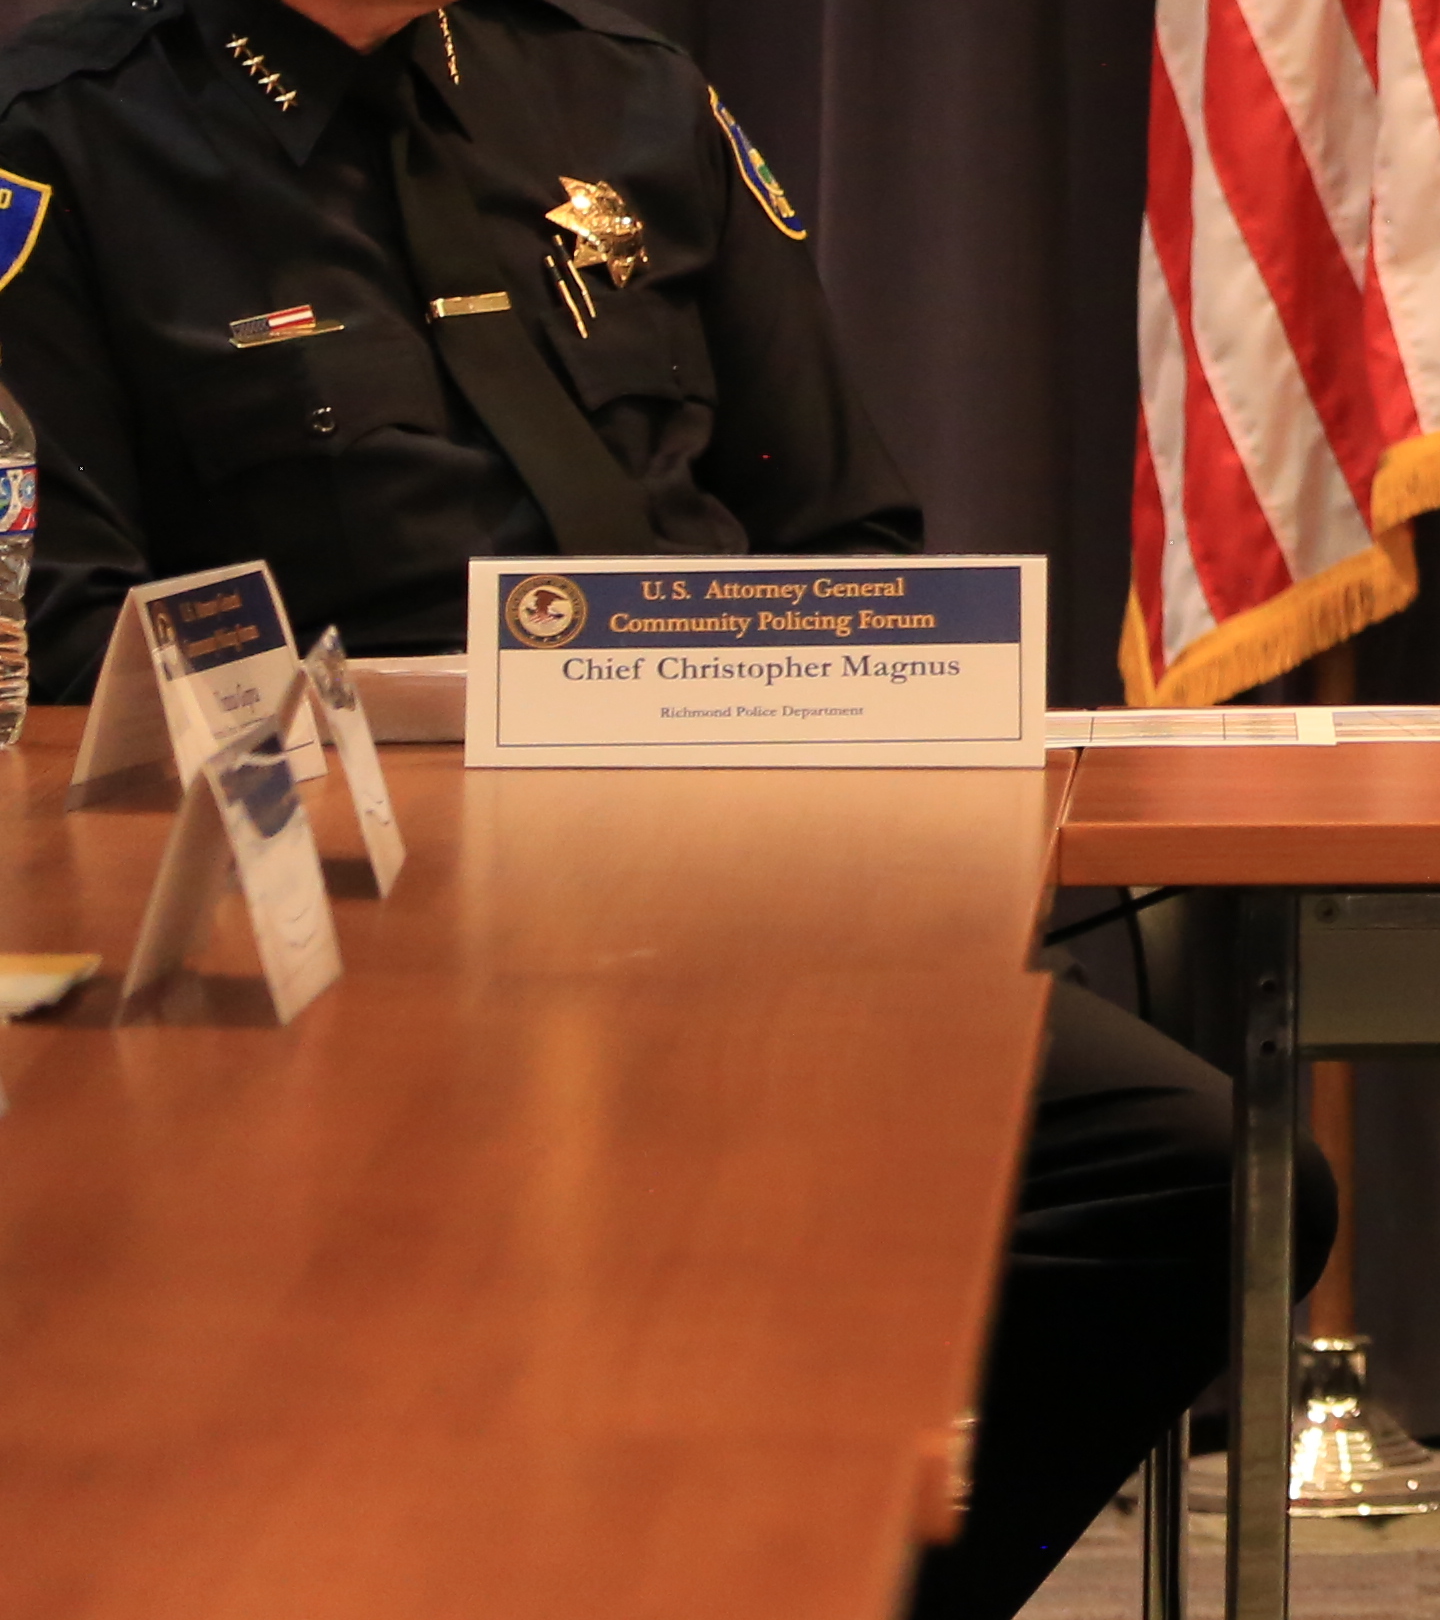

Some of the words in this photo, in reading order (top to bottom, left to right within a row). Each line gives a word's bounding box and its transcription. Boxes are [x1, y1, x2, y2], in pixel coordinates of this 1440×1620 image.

[705, 580, 808, 605] Attorney
[813, 578, 905, 598] General
[609, 612, 752, 638] Community
[758, 611, 851, 637] Policing
[858, 610, 936, 630] Forum
[562, 657, 645, 681] Chief
[657, 655, 832, 686] Christopher
[842, 654, 961, 683] Magnus
[660, 706, 732, 719] Richmond
[736, 706, 778, 718] Police
[782, 705, 864, 720] Department
